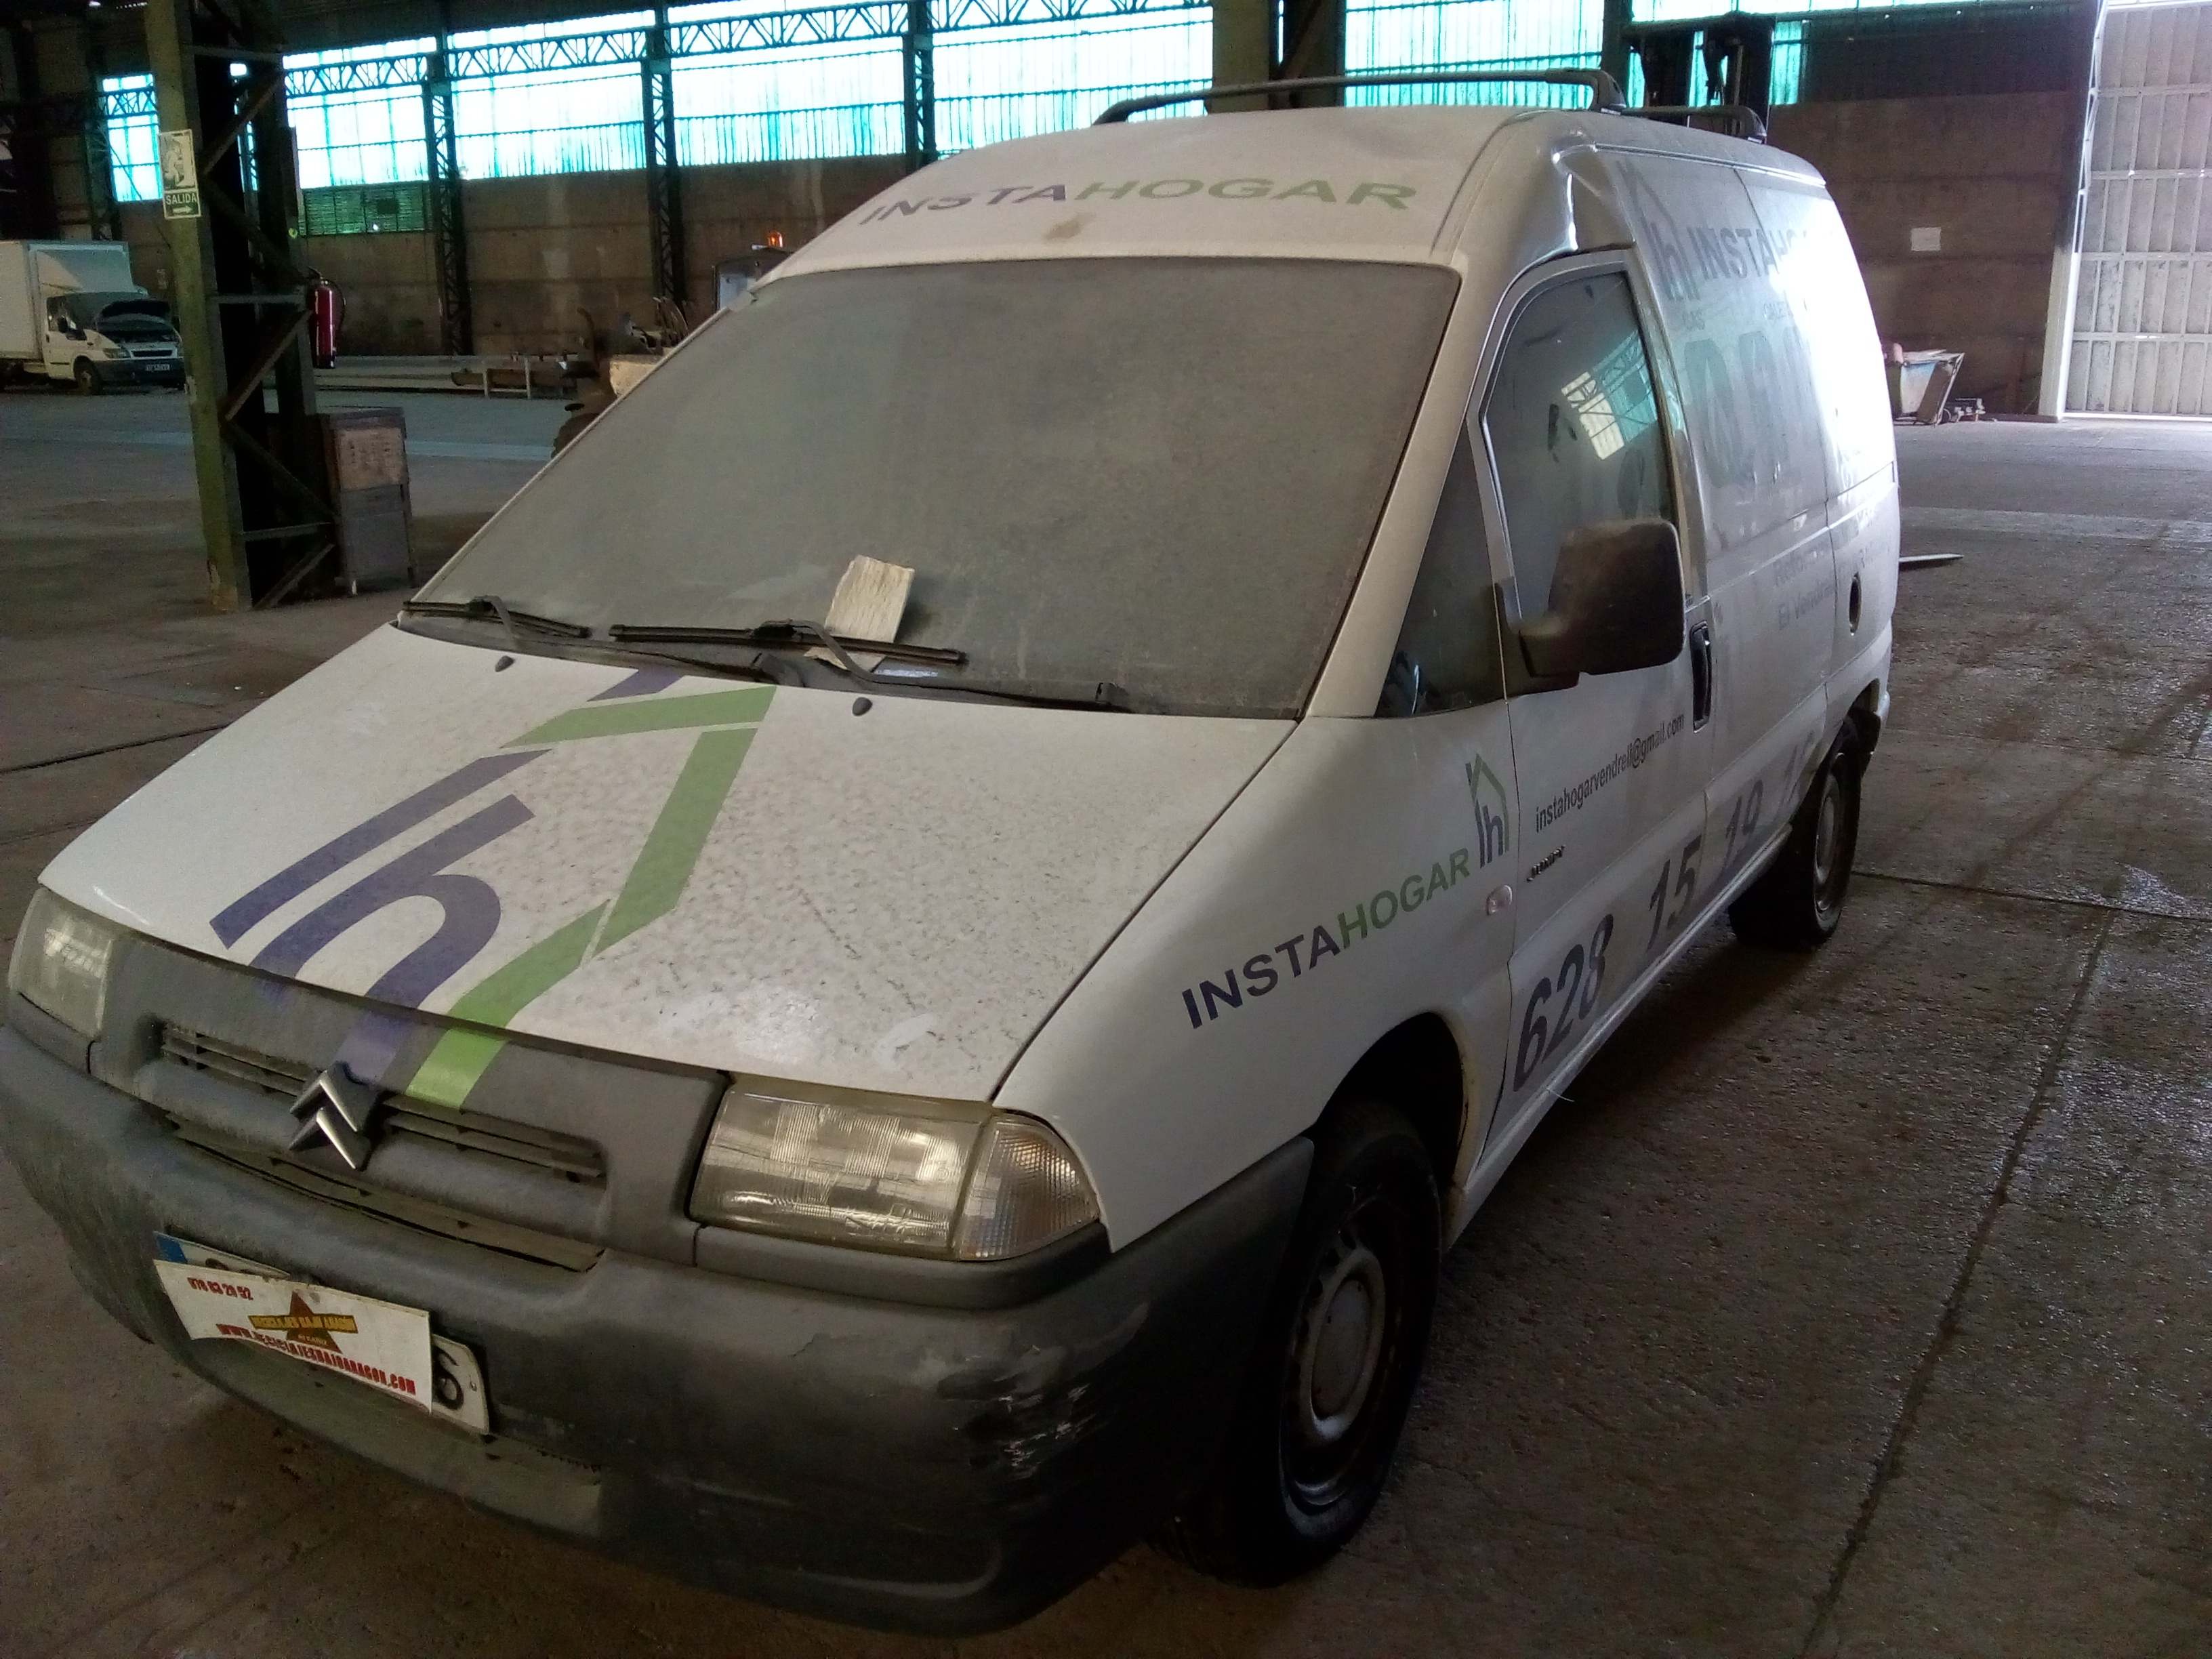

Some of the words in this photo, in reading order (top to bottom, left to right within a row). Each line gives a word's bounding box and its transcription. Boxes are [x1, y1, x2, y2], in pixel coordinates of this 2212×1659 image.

[165, 192, 197, 205] SALIDA
[860, 178, 1417, 226] INSTAHOGAR
[1535, 714, 1685, 834] instahogarvendrell@gmail.com
[1181, 847, 1471, 1029] INSTAHOGAR
[1513, 914, 1614, 1092] 628
[1646, 834, 1702, 951] 15
[1725, 779, 1764, 869] 19
